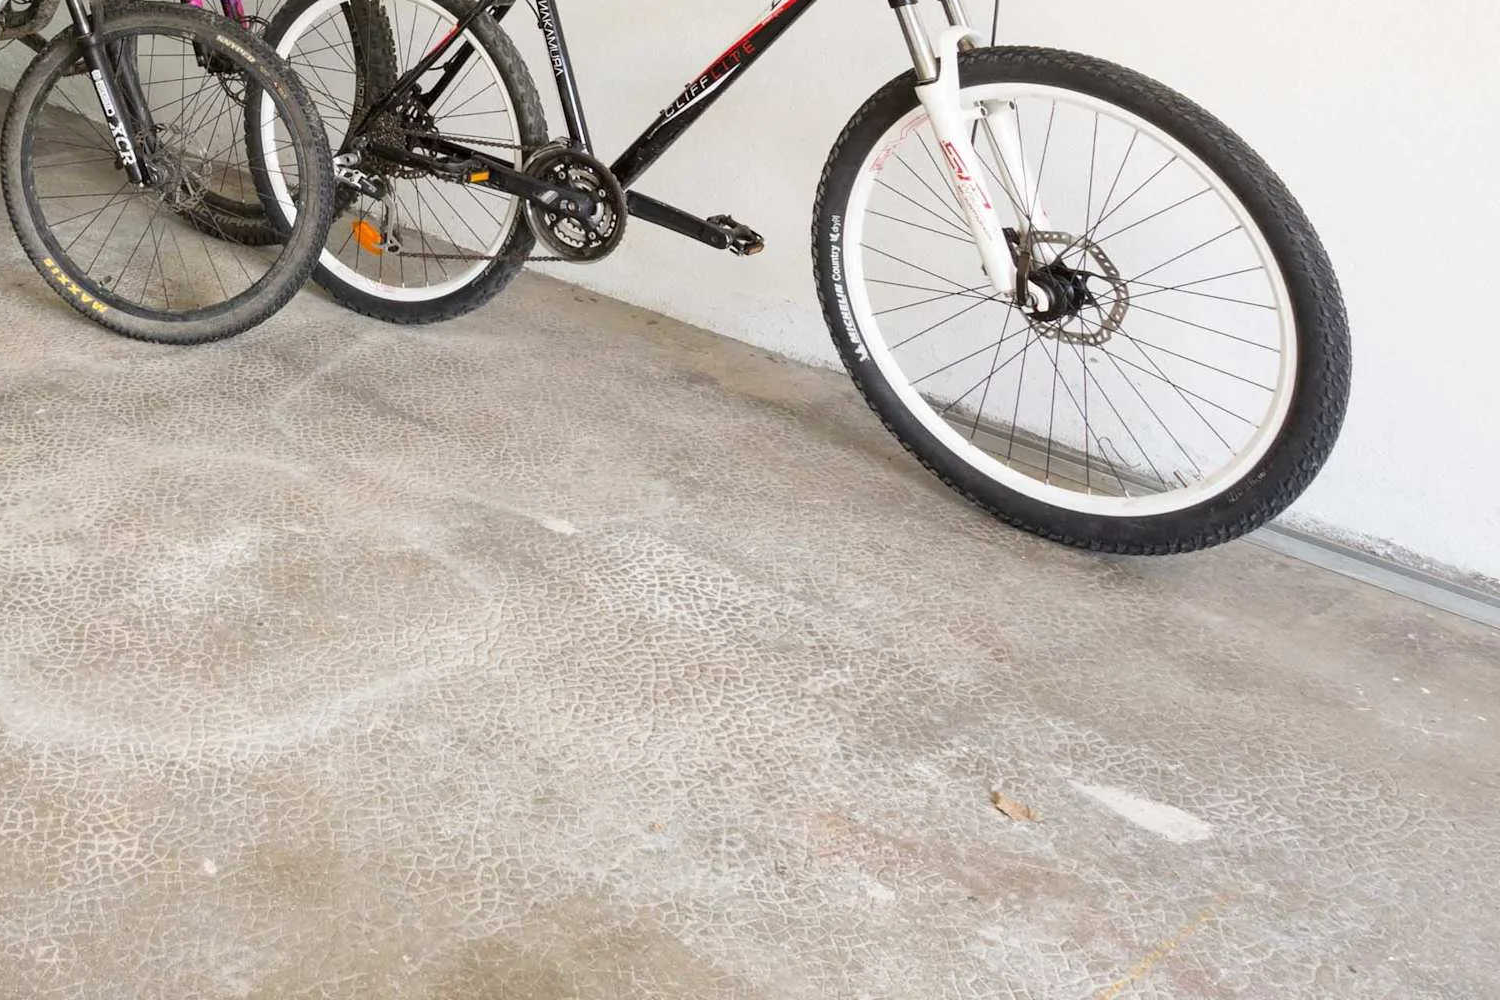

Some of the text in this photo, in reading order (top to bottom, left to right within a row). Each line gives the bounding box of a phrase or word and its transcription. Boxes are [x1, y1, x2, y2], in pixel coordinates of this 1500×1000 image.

[538, 0, 564, 77] NAKAMURA
[664, 40, 756, 118] CLIFF LITE
[108, 121, 137, 166] XCR
[43, 258, 108, 313] MAXXIS
[831, 243, 842, 281] Country
[834, 283, 861, 344] MICHELIN
